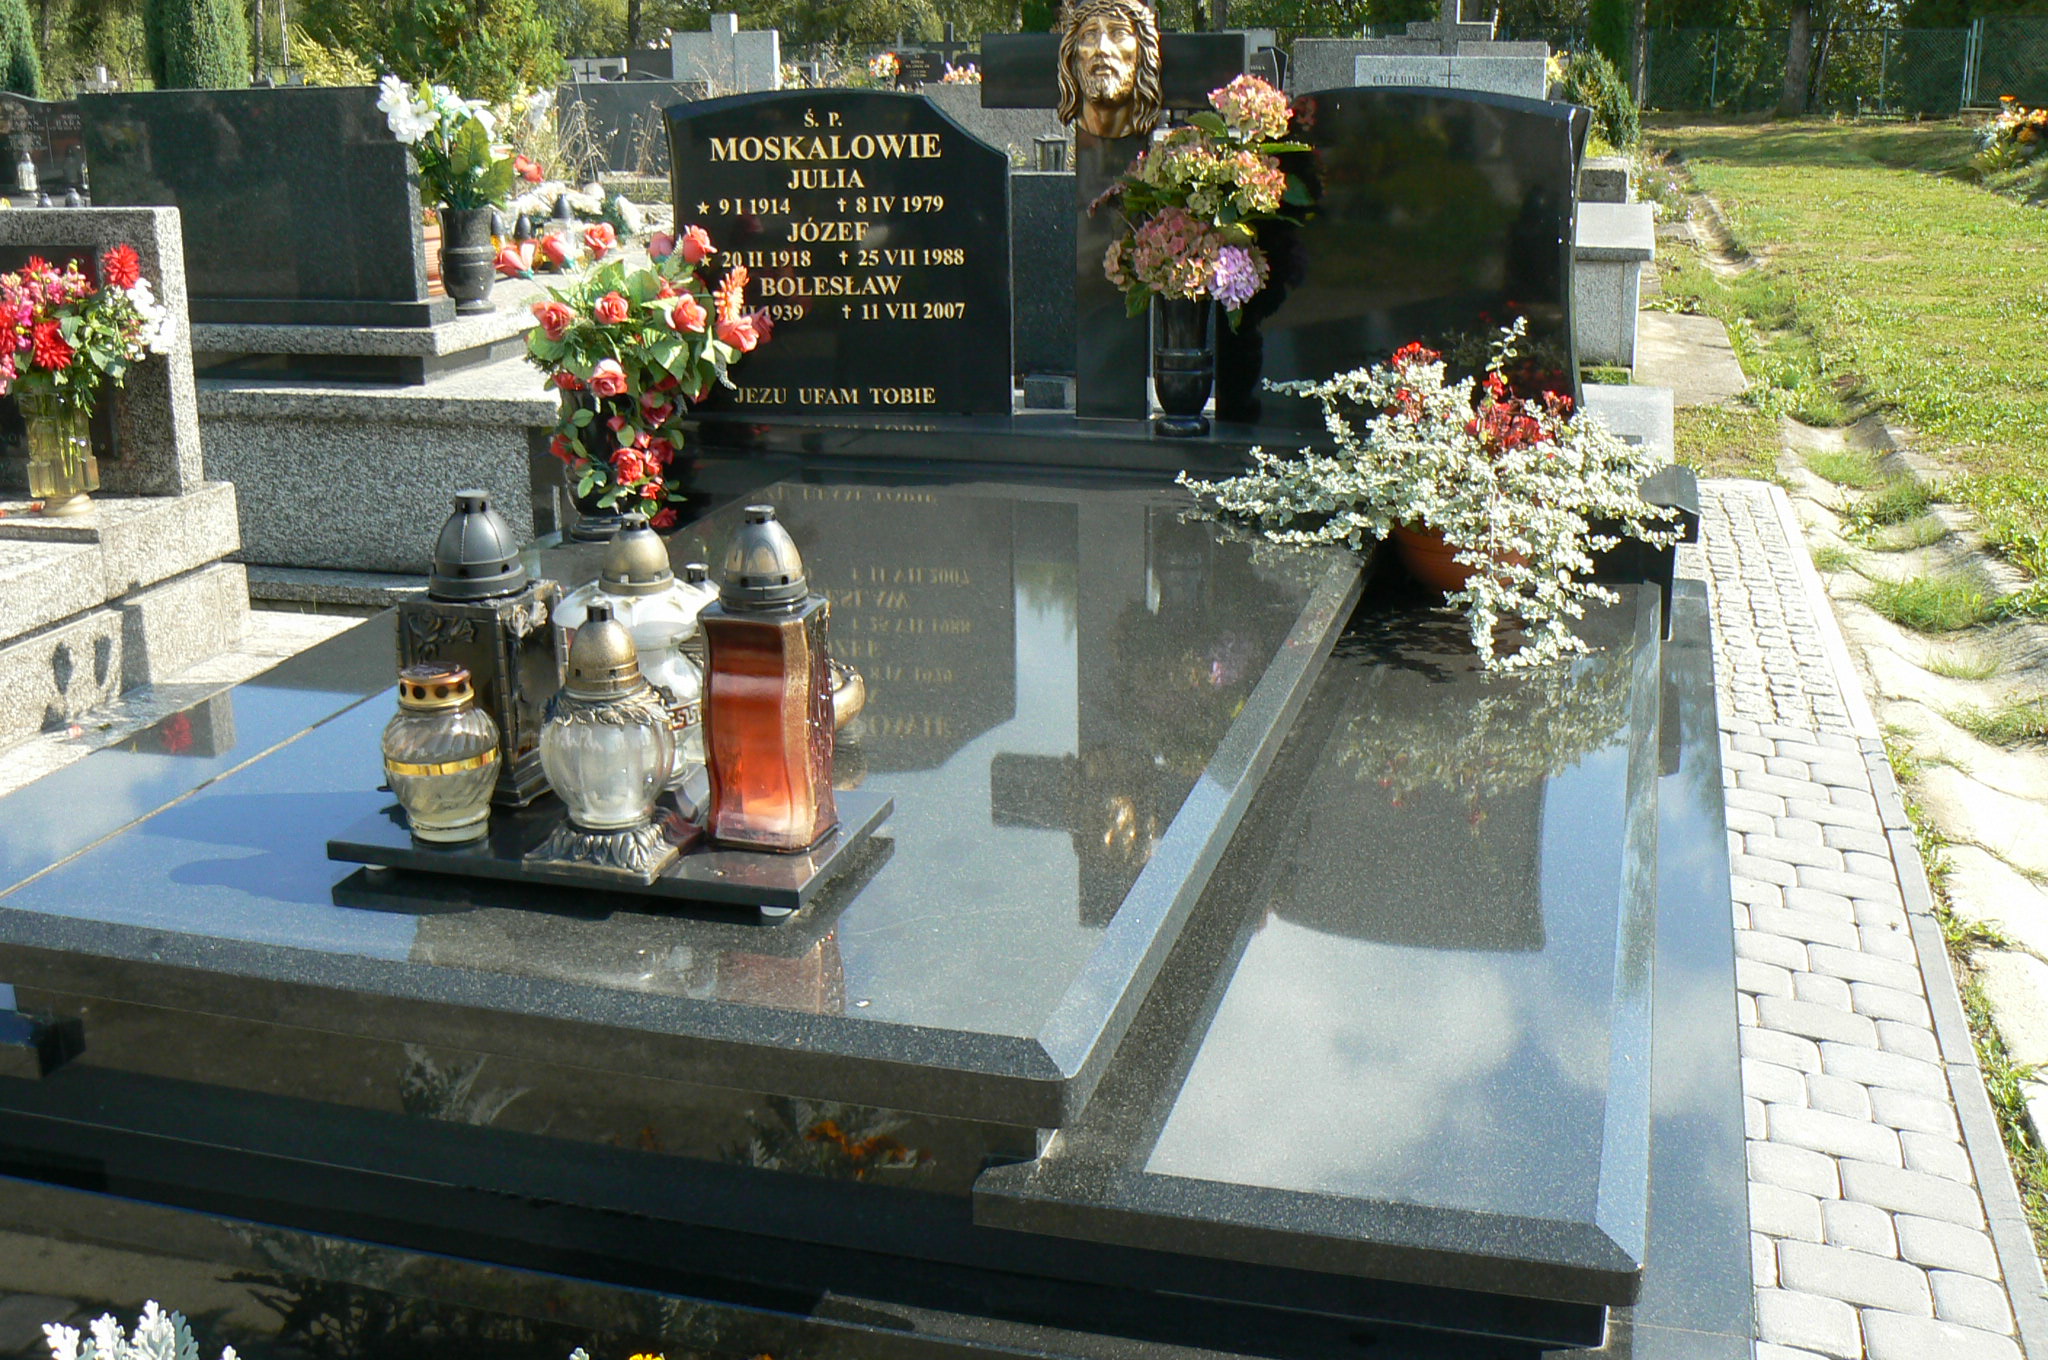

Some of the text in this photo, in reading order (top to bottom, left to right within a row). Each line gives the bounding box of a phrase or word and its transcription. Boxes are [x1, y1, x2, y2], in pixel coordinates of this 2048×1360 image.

[828, 112, 842, 127] P.
[709, 133, 942, 162] MOSKALOWIE
[787, 168, 865, 190] JULIA
[719, 198, 791, 216] 9 I 1914
[856, 195, 944, 214] 8 IV 1979
[786, 217, 870, 243] JÓZEF
[721, 250, 812, 268] 20 II 1918
[857, 249, 965, 267] 25 VII 1988
[760, 275, 902, 297] BOLESŁAW
[763, 304, 804, 321] 1939
[861, 302, 966, 320] 11 VII 2007
[734, 386, 936, 405] JEZU UFAM TOBIE
